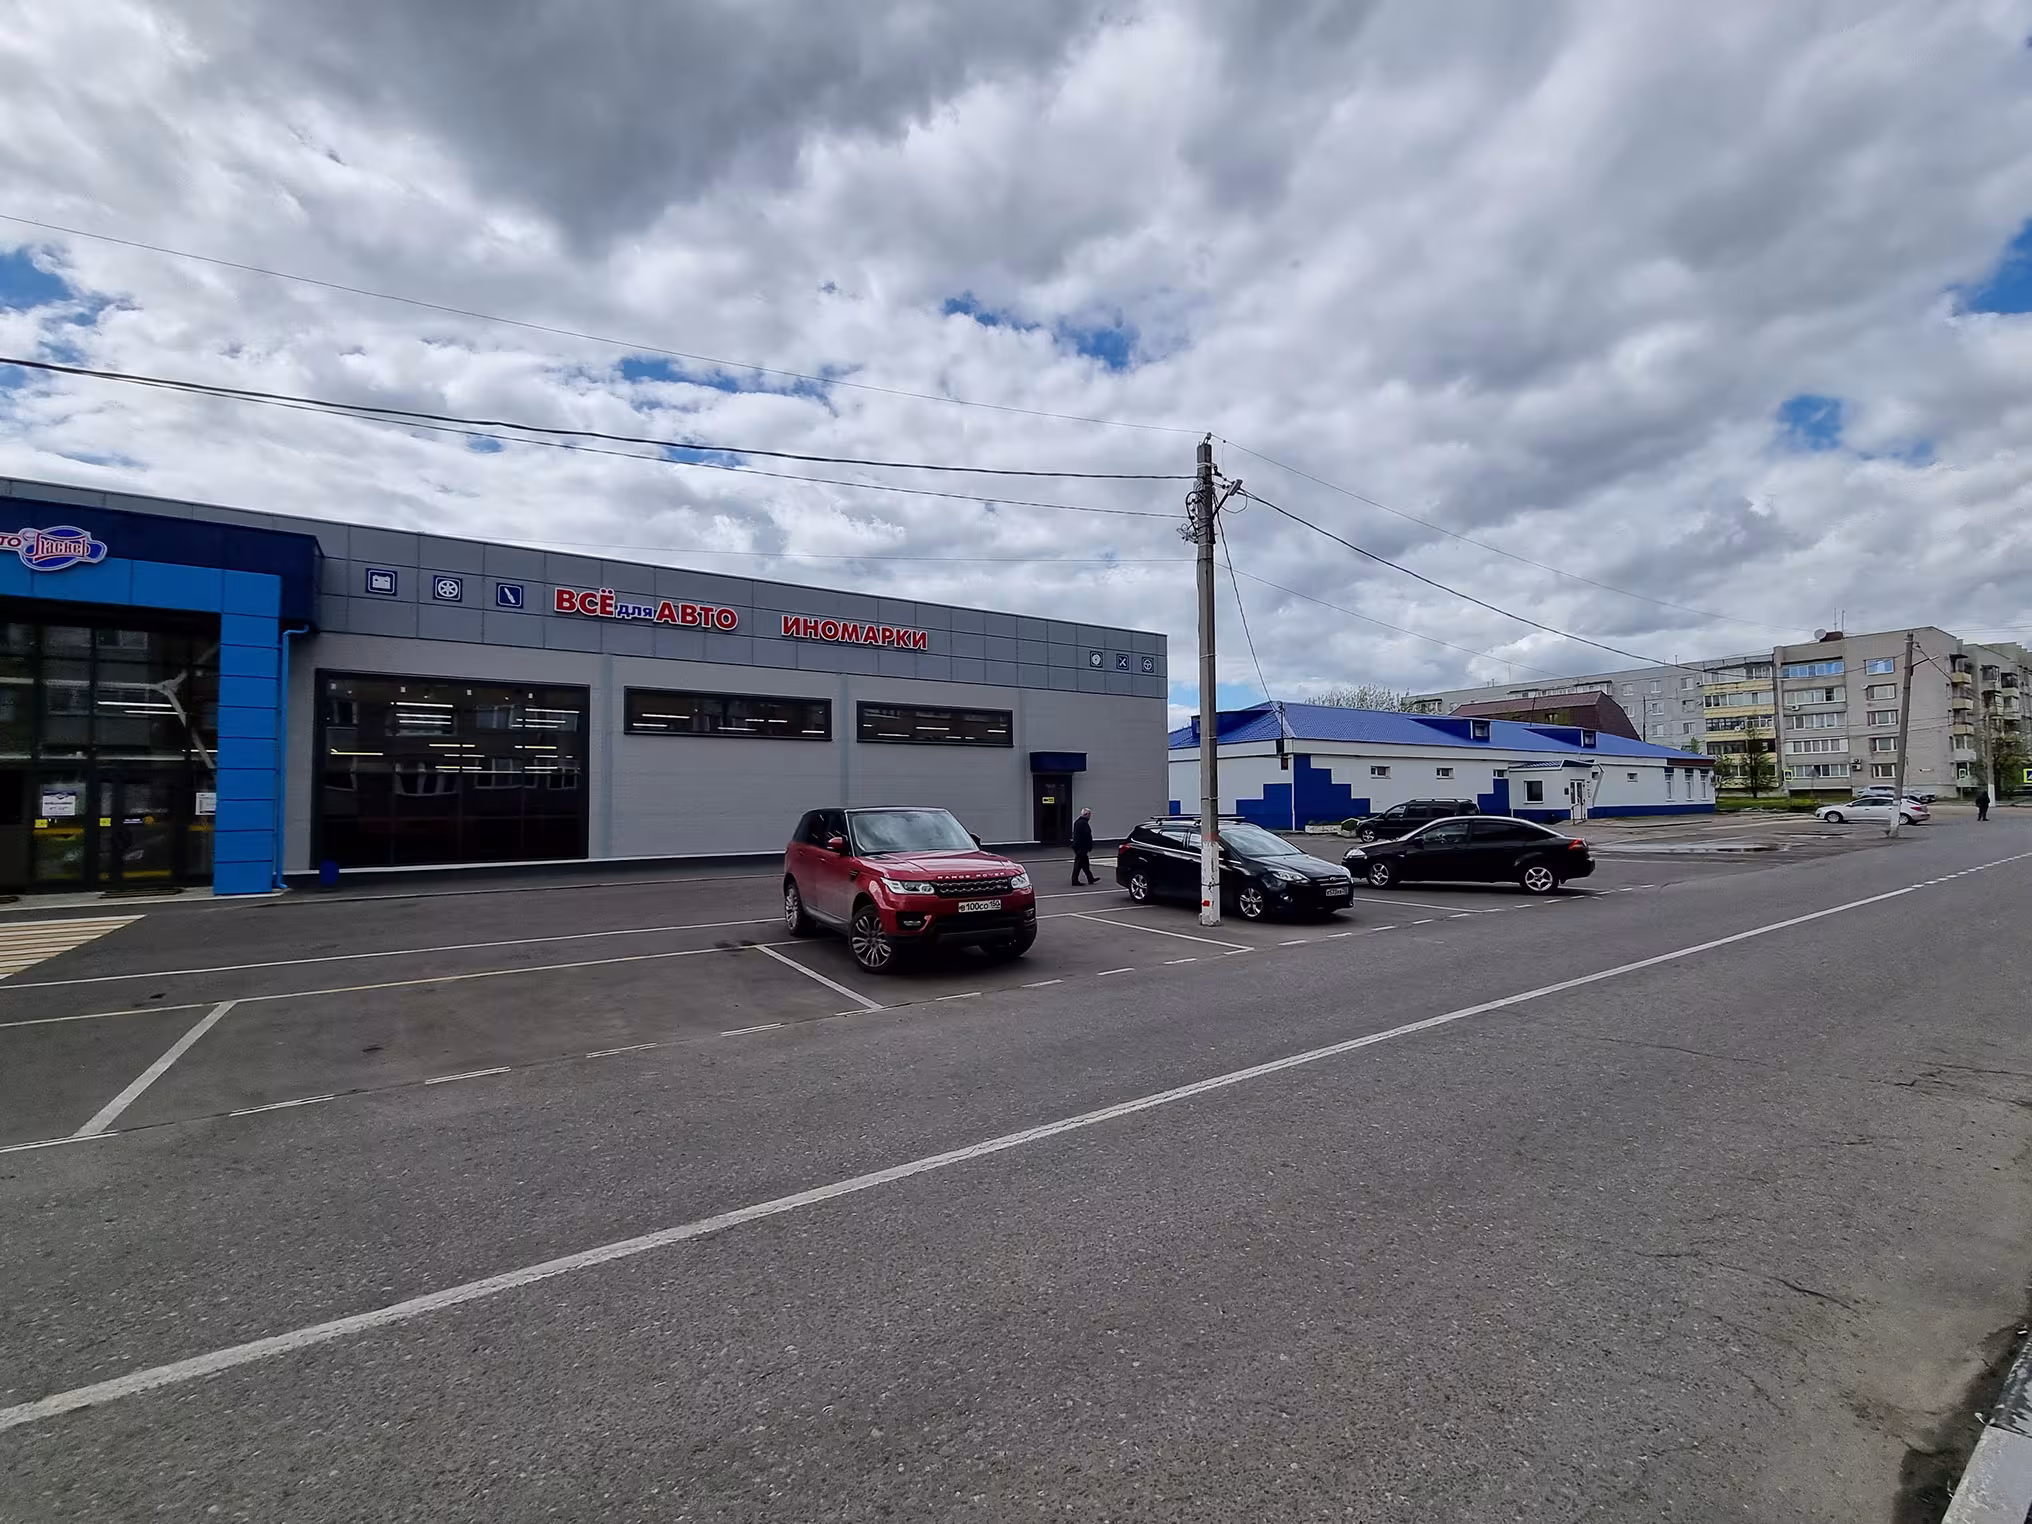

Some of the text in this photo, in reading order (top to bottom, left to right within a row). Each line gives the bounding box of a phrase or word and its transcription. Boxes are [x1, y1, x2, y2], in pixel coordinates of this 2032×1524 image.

[554, 588, 739, 631] ВСЁ для АВТО
[781, 615, 928, 650] ИНОМАРКИ
